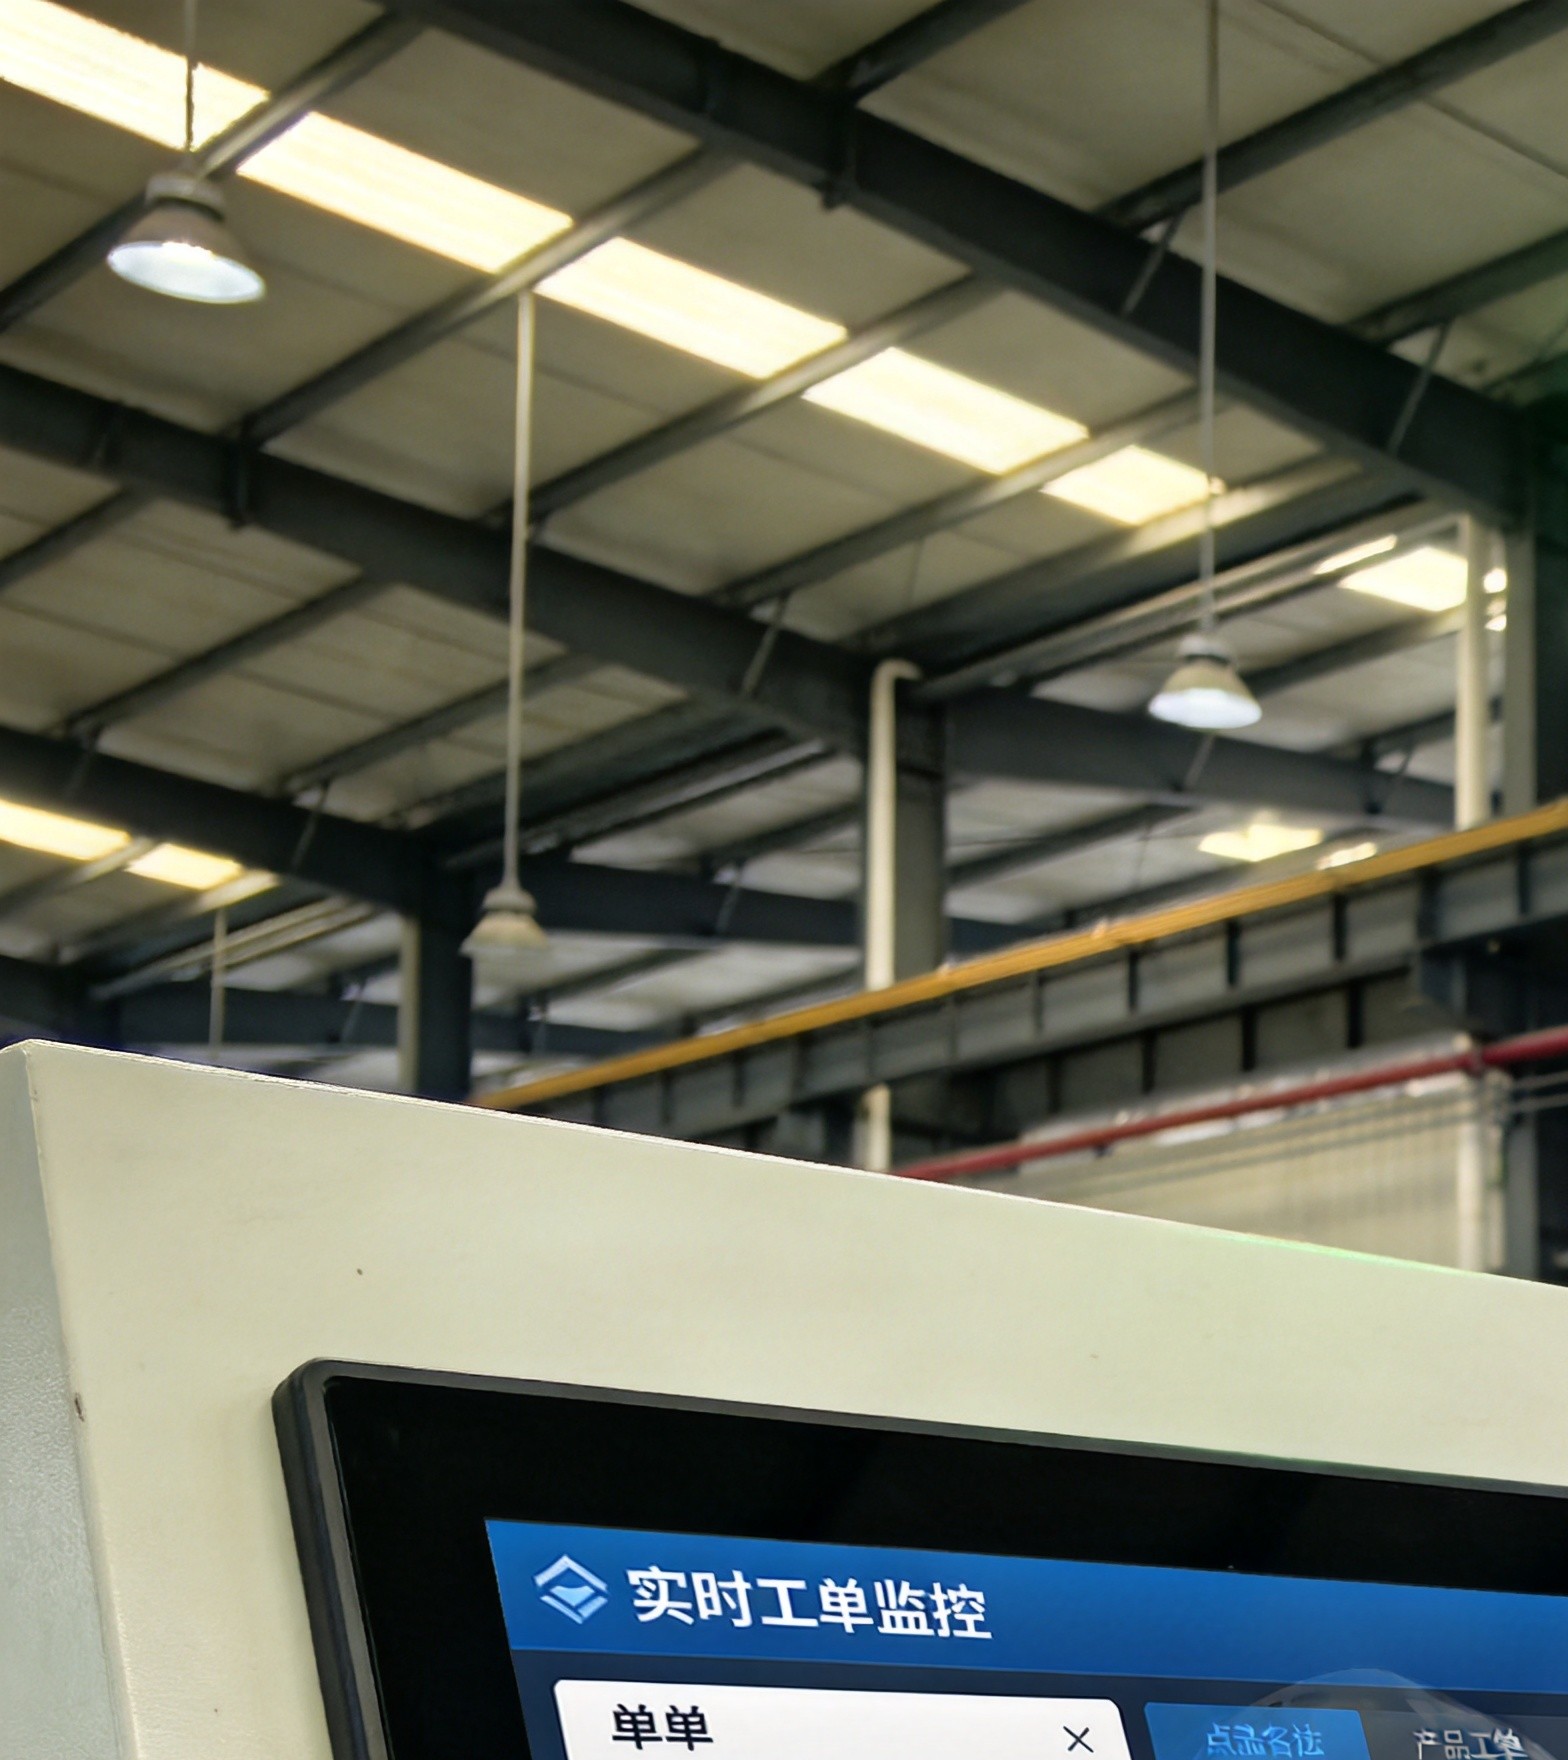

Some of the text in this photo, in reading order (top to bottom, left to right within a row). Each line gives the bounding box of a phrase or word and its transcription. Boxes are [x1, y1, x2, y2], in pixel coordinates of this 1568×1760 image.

[626, 1565, 994, 1640] 实时工单监控
[610, 1703, 714, 1751] 单单
